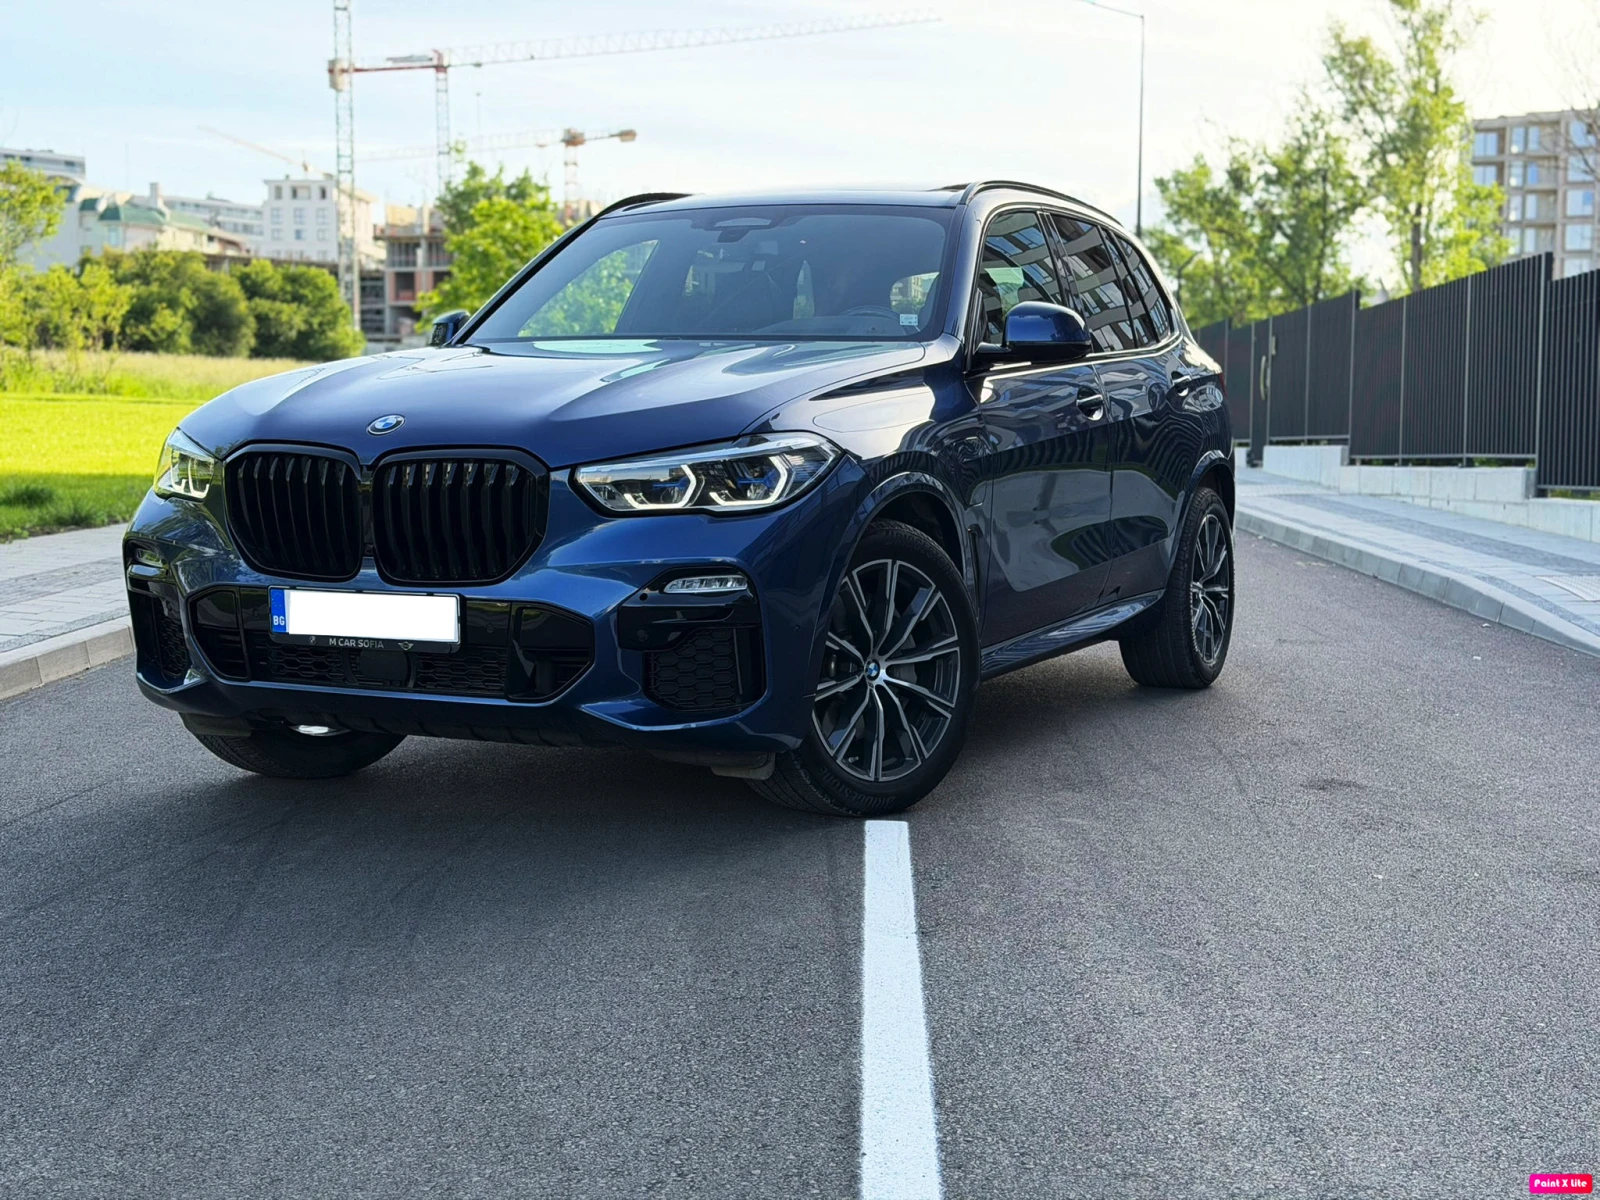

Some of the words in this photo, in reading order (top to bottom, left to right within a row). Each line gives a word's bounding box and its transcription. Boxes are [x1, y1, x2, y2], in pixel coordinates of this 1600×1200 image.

[273, 615, 285, 626] BG
[329, 638, 337, 646] M
[338, 638, 356, 647] CAR
[358, 639, 384, 649] SOFIA
